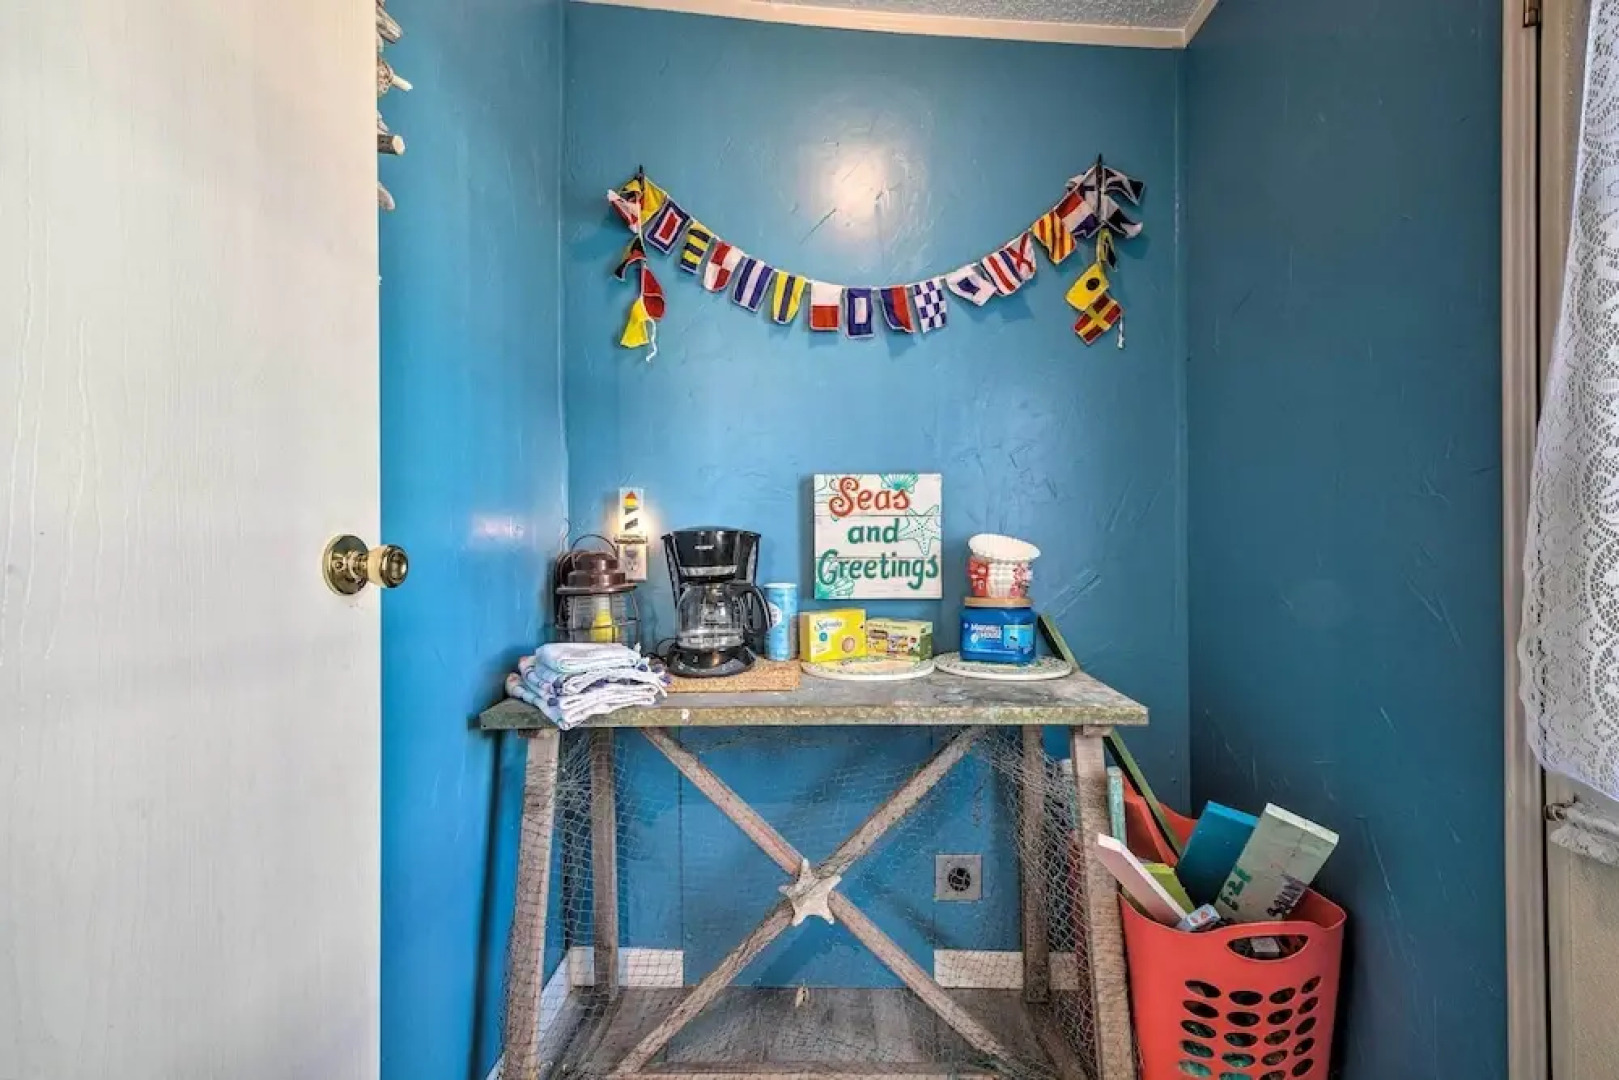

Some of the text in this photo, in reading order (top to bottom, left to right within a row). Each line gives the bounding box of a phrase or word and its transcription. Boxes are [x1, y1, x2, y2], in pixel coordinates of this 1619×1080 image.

[829, 477, 911, 517] Seas
[847, 517, 900, 544] and
[818, 548, 940, 590] Greetings
